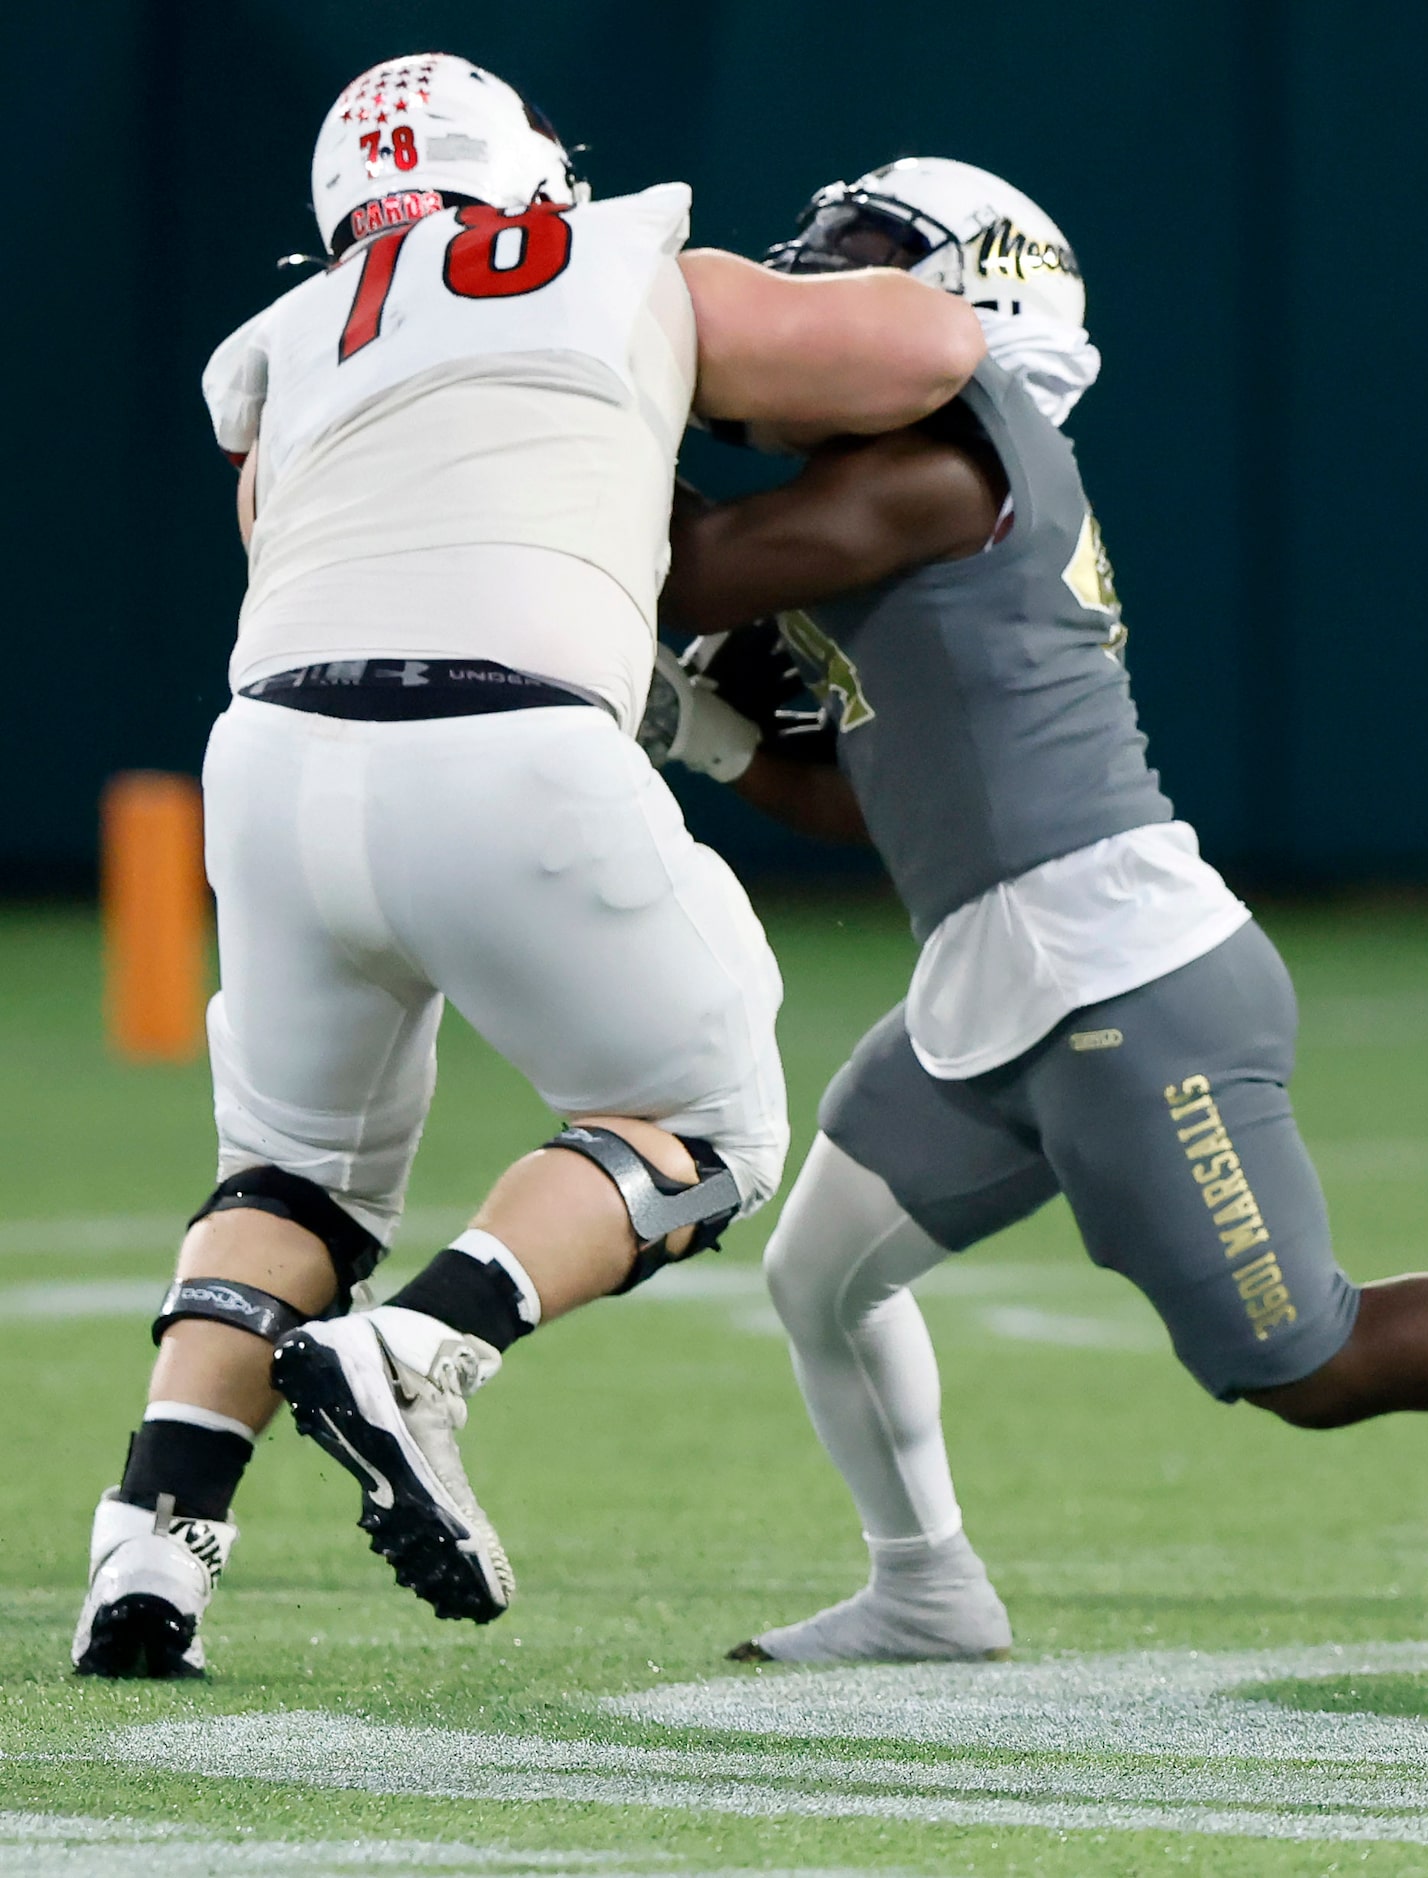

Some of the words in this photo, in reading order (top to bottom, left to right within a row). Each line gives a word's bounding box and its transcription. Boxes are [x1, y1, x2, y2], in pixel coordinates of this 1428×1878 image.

[359, 125, 418, 180] 78
[338, 203, 574, 366] 78
[1163, 1073, 1271, 1260] MARSALIS
[1231, 1250, 1297, 1341] 3601
